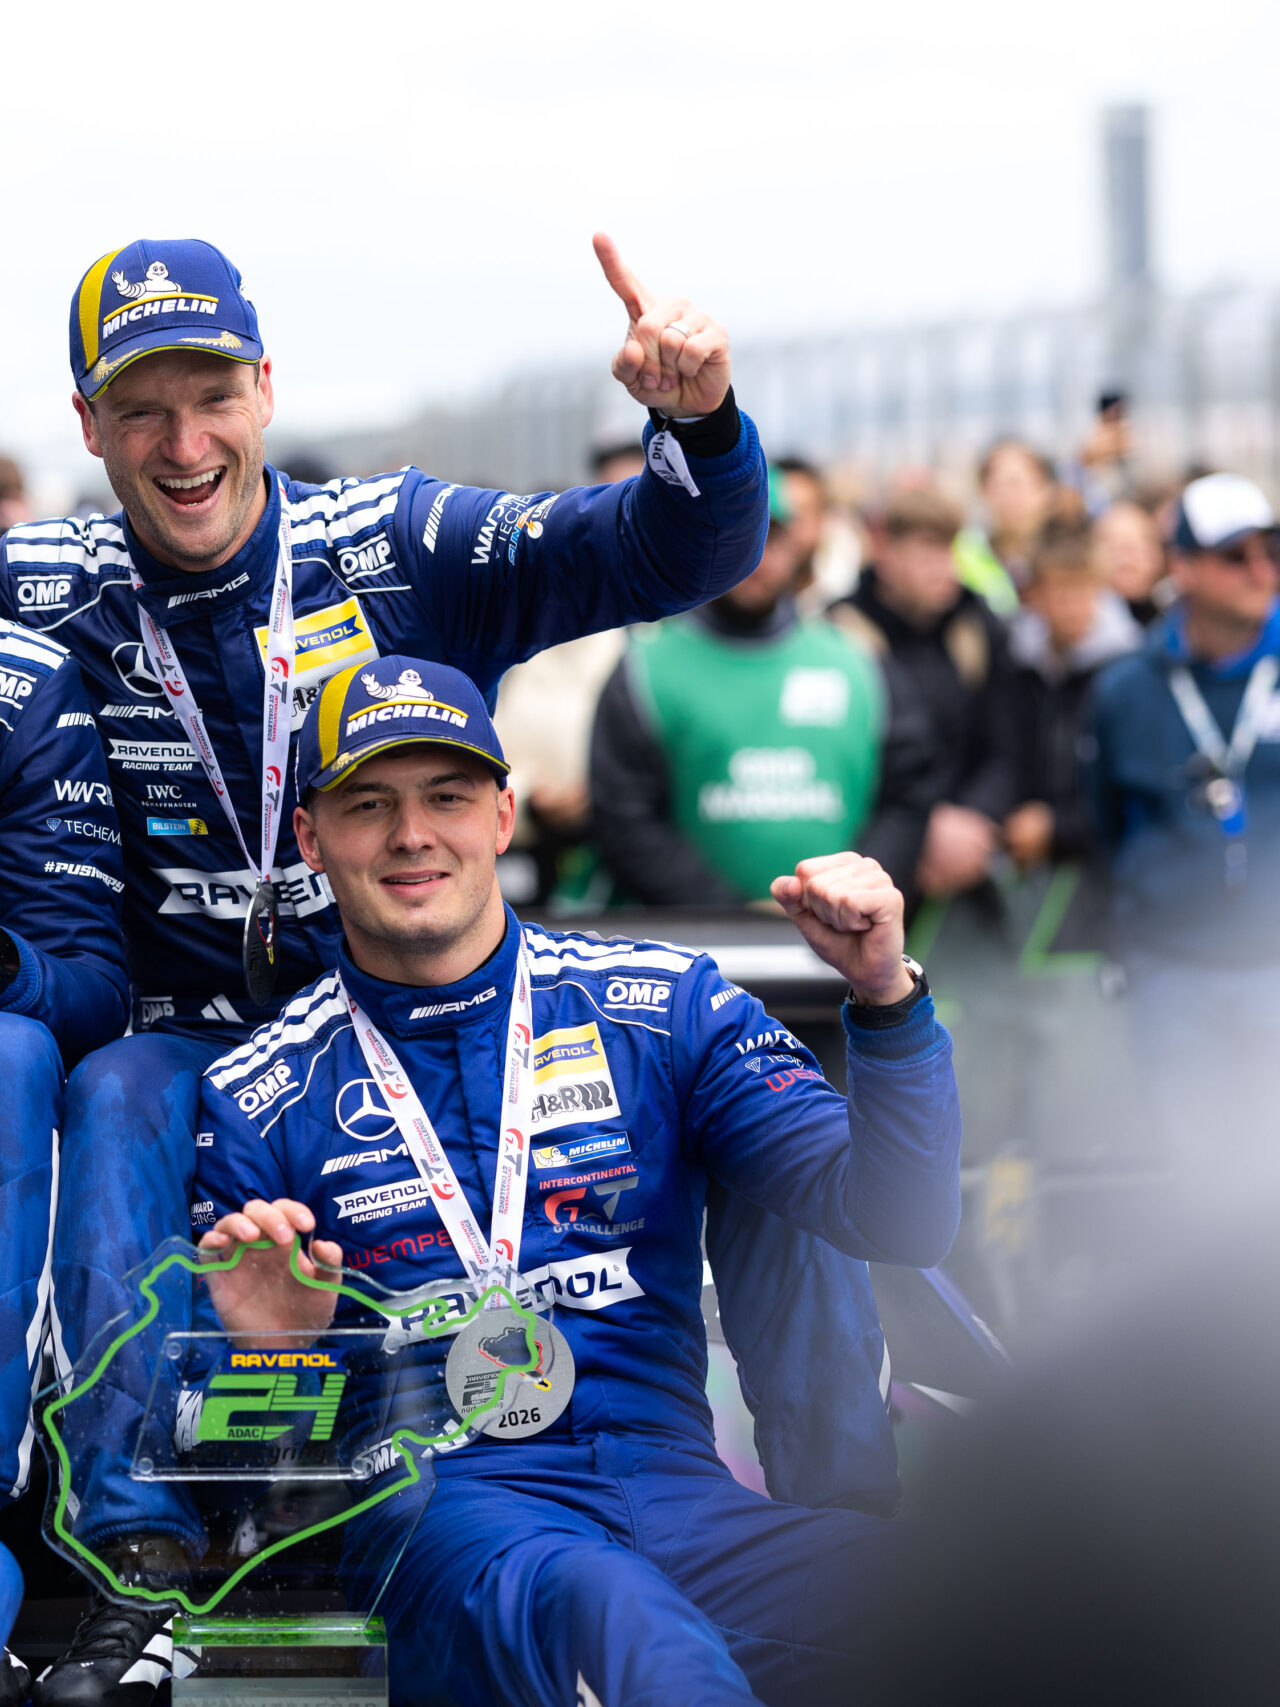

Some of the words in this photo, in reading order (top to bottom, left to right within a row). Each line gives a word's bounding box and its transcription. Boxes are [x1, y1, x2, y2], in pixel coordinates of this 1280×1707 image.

[102, 298, 218, 340] MICHELIN
[340, 540, 391, 575] OMP
[18, 580, 70, 605] OMP
[194, 572, 250, 600] AMG
[295, 626, 353, 650] VENOL
[345, 704, 469, 737] MICHELIN
[118, 745, 195, 757] RAVENOL
[122, 762, 160, 771] RACING
[163, 763, 193, 771] TEAM
[146, 785, 182, 799] IWC
[64, 820, 122, 847] TECHEM
[152, 822, 186, 831] BILSTEIN
[440, 987, 497, 1014] AMG
[606, 981, 670, 1005] OMP
[534, 1046, 590, 1067] AVENOL
[238, 1064, 291, 1112] OMP
[569, 1137, 626, 1155] MICHELIN
[539, 1164, 637, 1190] INTERCONTINENTAL
[344, 1184, 428, 1211] RAVENOL
[351, 1208, 393, 1225] RACING
[396, 1199, 427, 1213] TEAM
[553, 1222, 569, 1234] GT
[573, 1218, 645, 1235] CHALLENGE
[231, 1354, 336, 1368] RAVENOL
[196, 1374, 347, 1441] 24
[498, 1408, 541, 1428] 2026
[228, 1429, 260, 1438] ADAC
